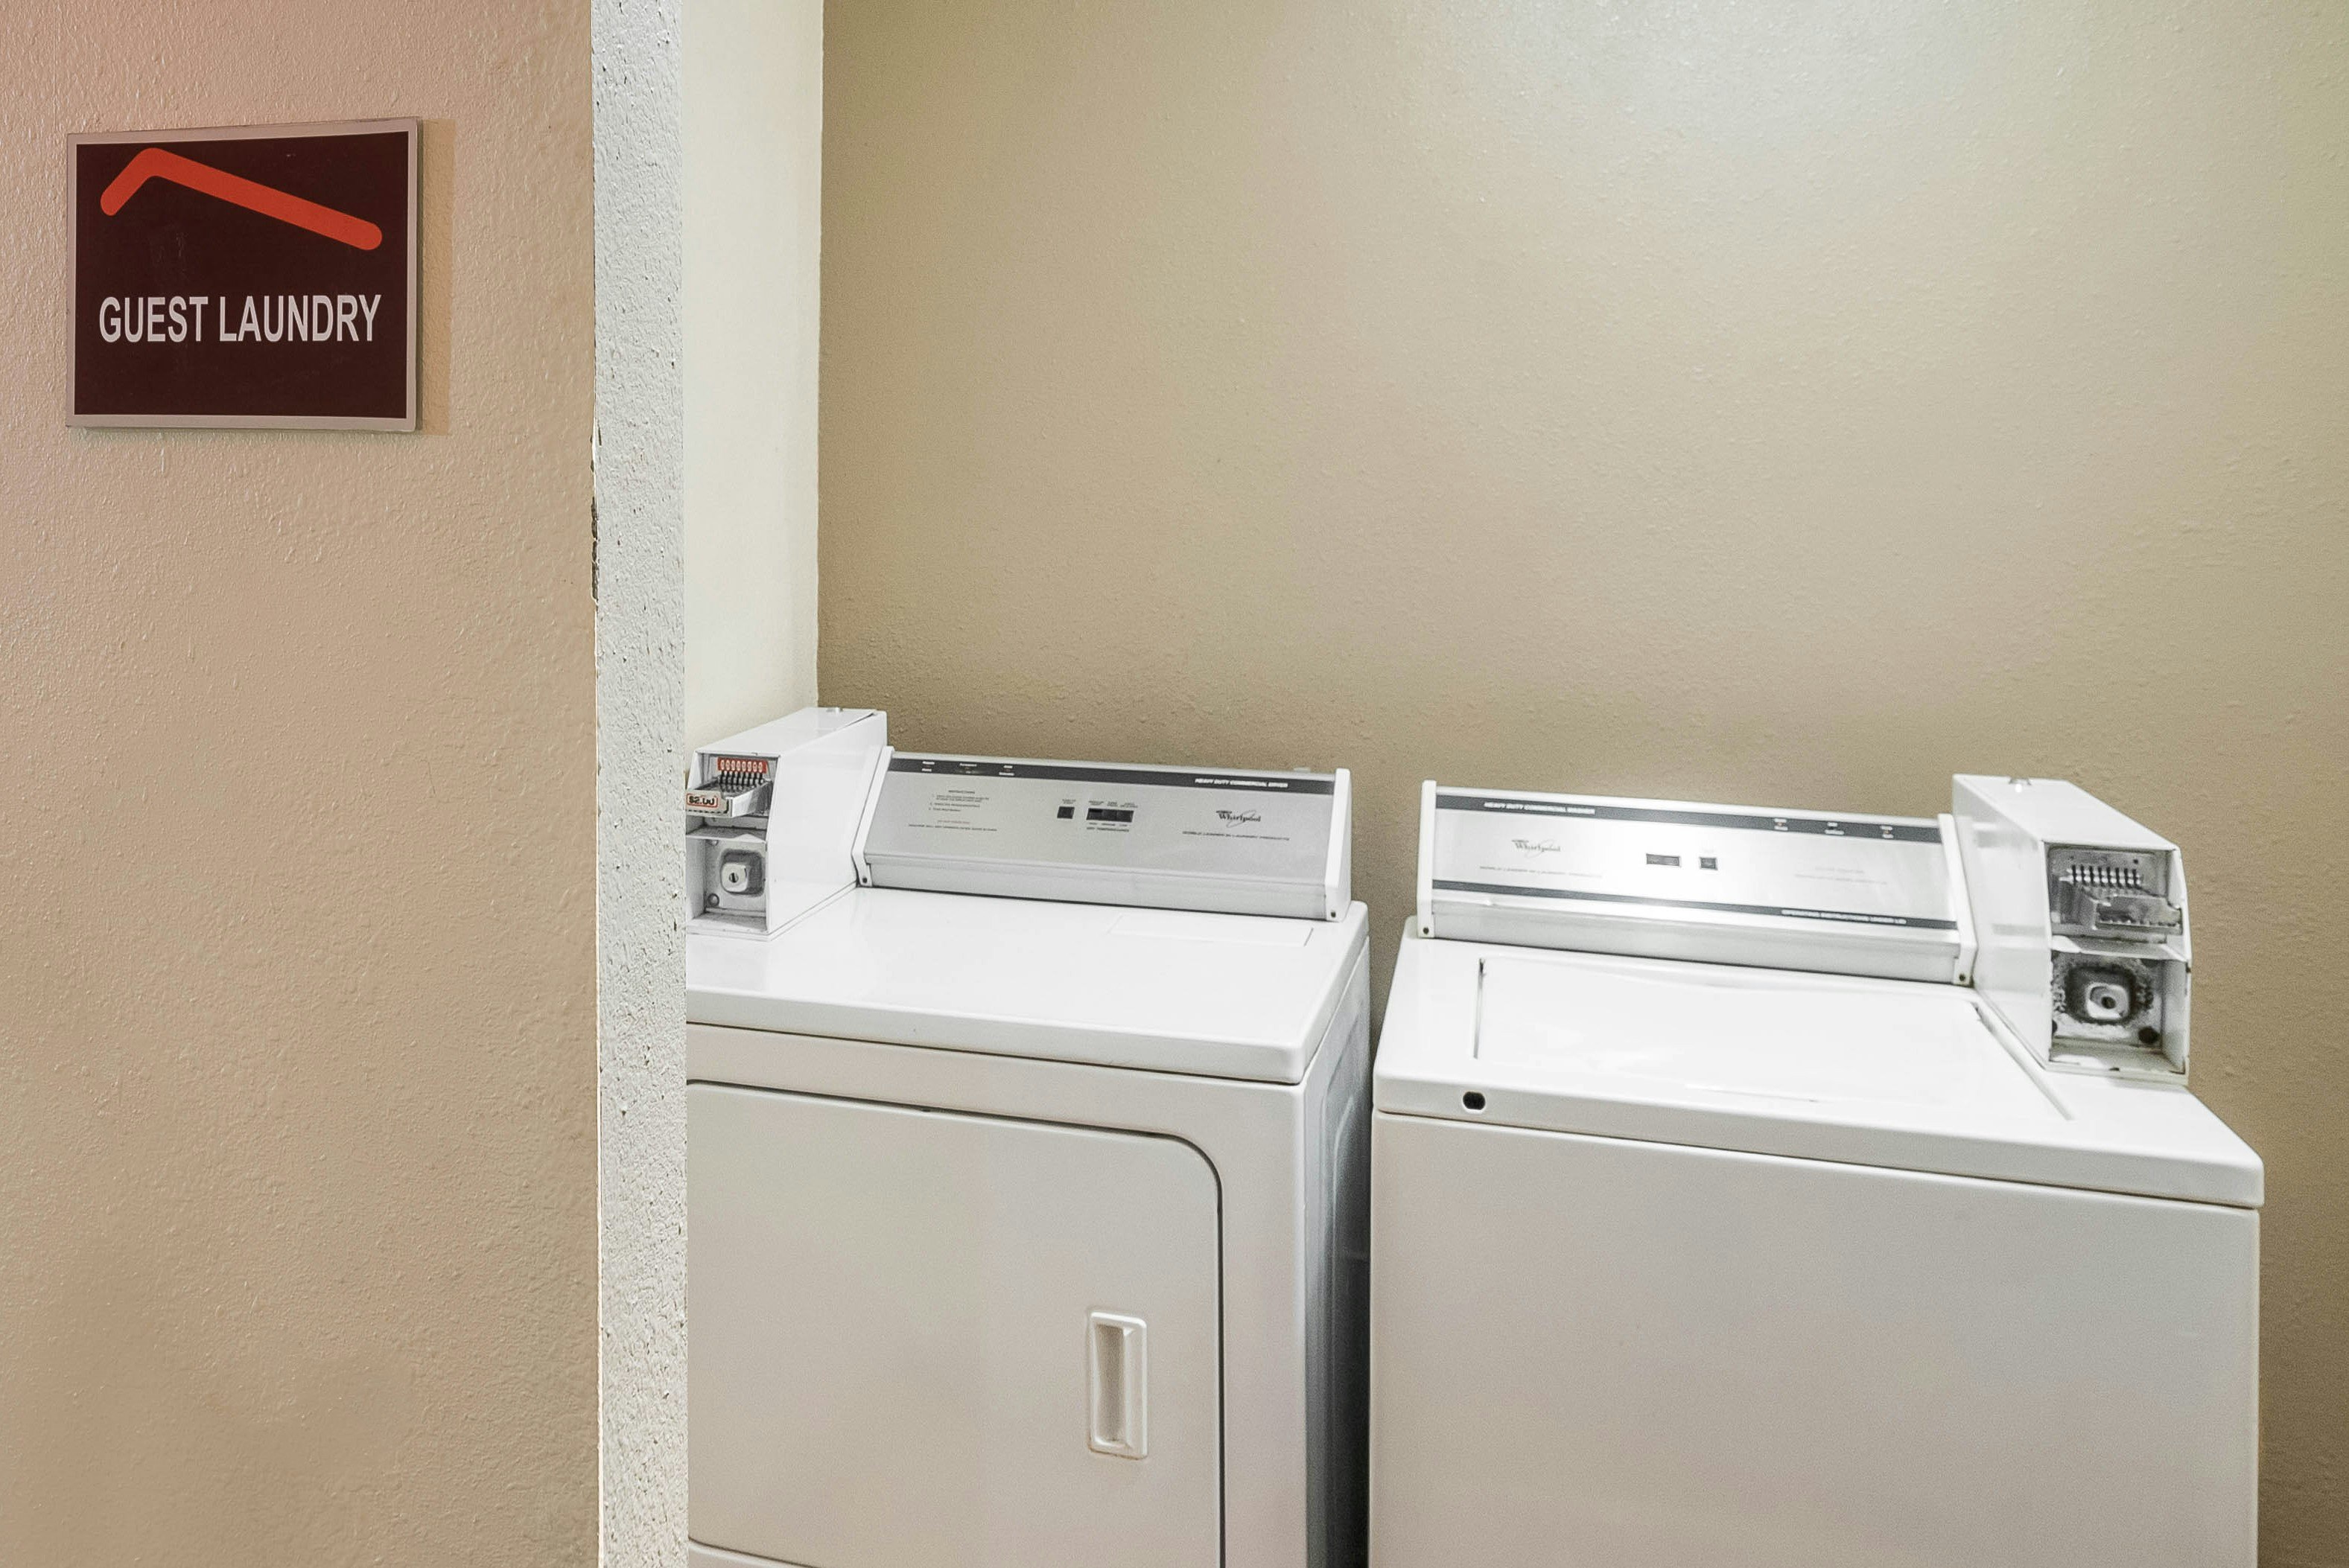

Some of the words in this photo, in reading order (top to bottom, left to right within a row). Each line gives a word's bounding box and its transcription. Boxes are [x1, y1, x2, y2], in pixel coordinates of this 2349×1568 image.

[99, 296, 209, 343] GUEST
[219, 294, 381, 342] LAUNDRY
[1215, 810, 1262, 823] Whirlpool
